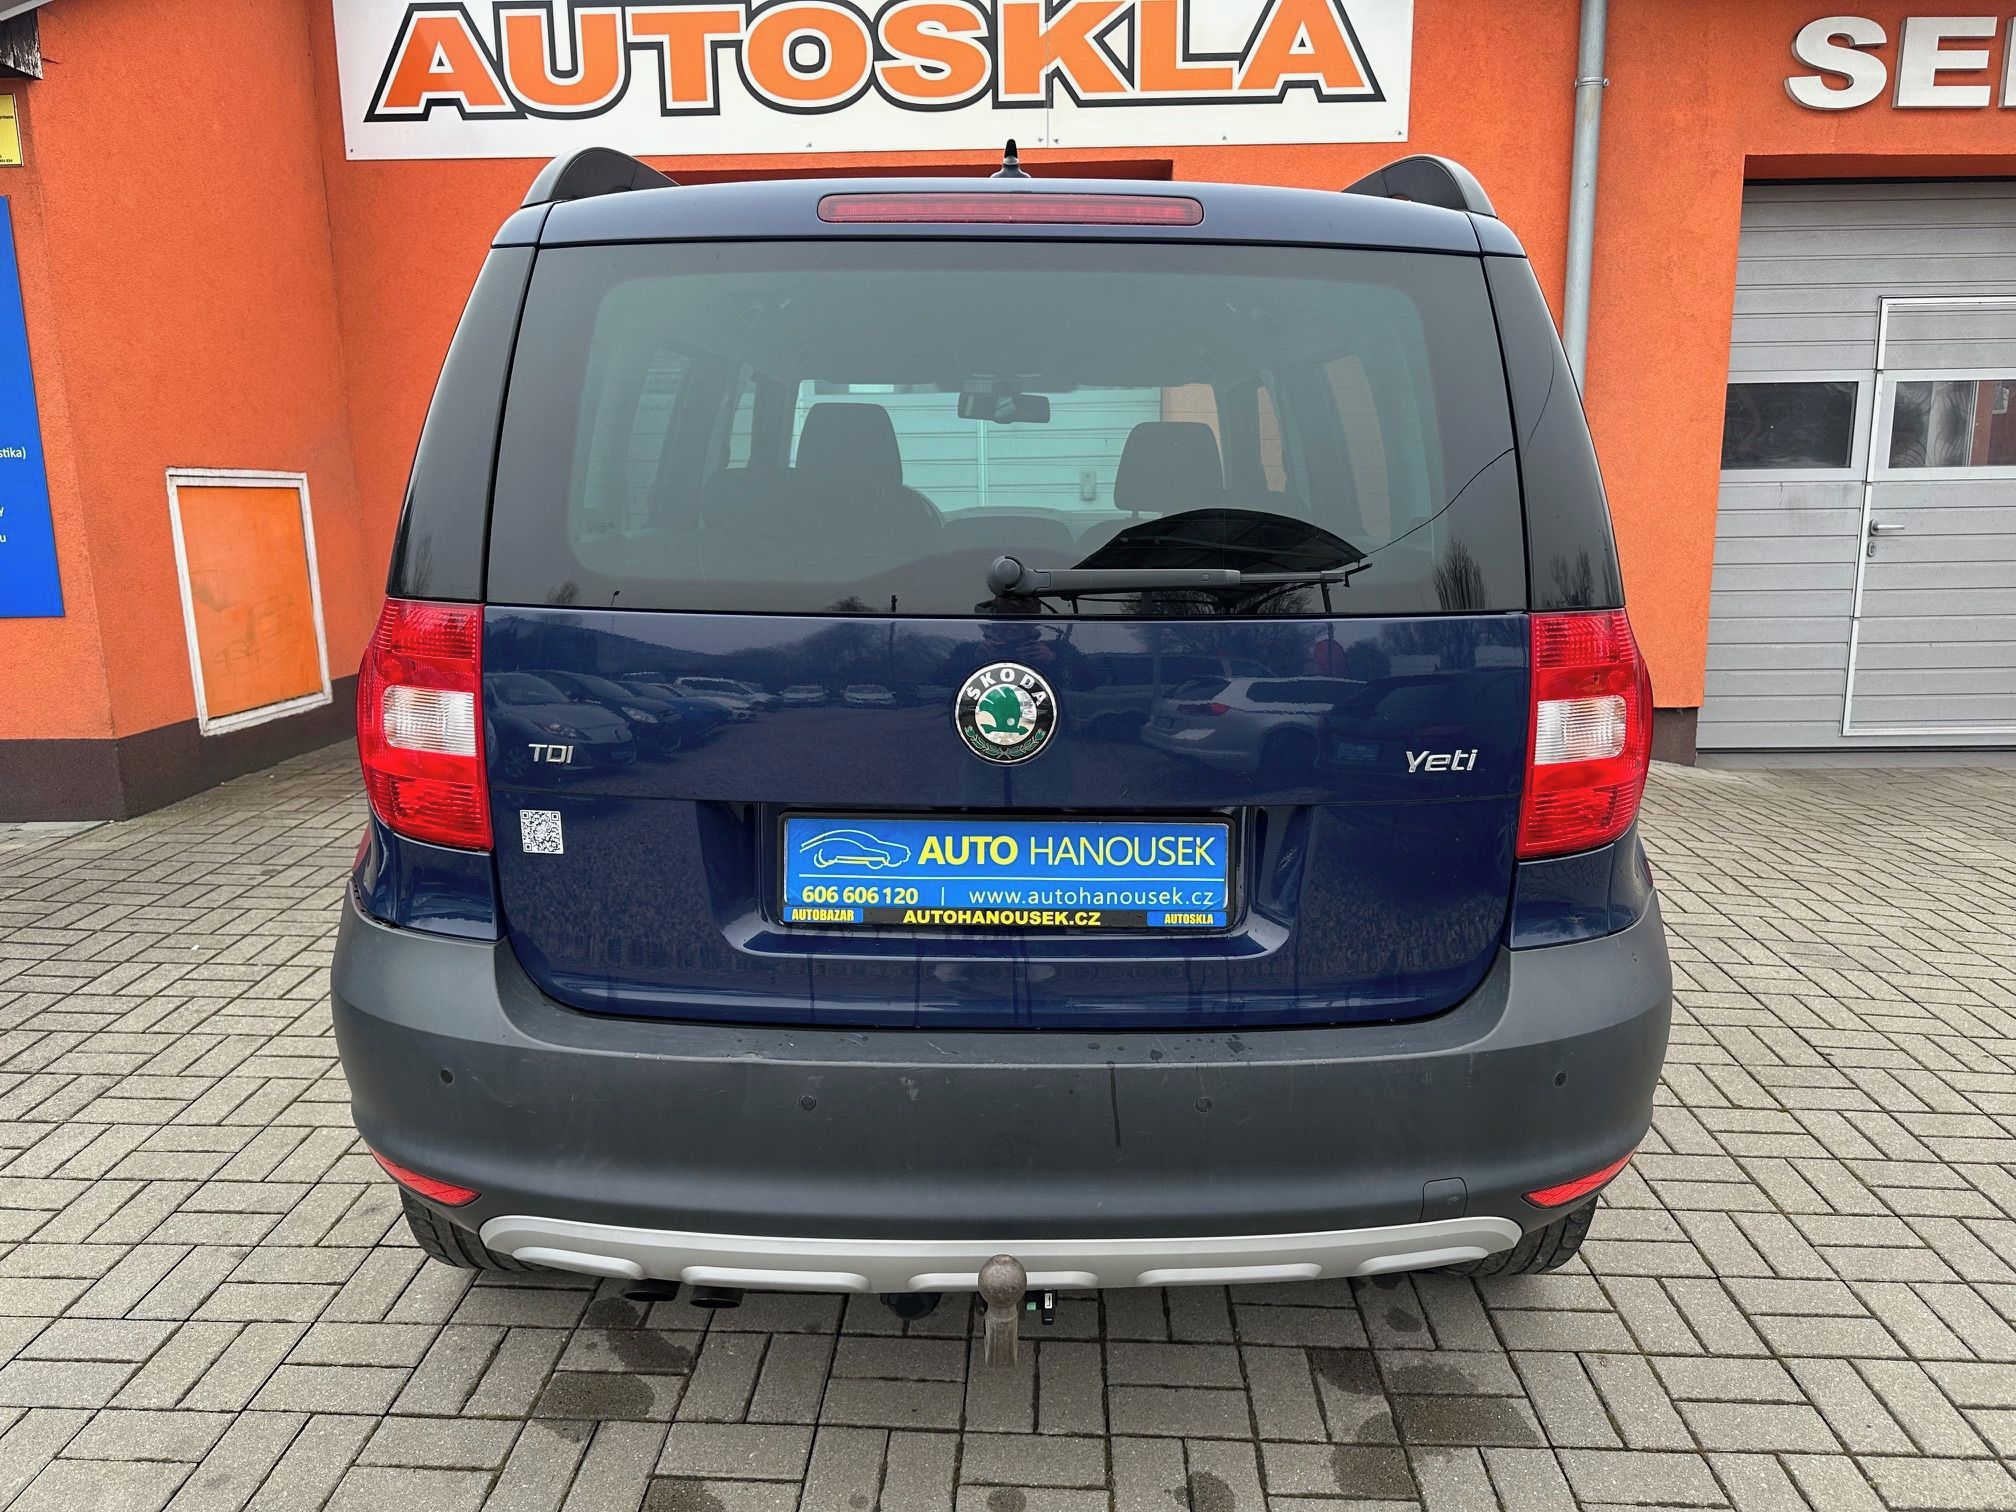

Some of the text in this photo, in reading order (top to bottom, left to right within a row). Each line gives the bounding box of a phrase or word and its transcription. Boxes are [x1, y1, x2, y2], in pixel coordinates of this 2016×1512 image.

[364, 0, 1386, 121] AUTOSKLA
[1784, 16, 2016, 110] SE
[528, 744, 575, 764] TDI
[1405, 749, 1478, 773] Yeti
[917, 835, 1215, 867] AUTO HANOUSEK
[802, 886, 919, 905] 606 606 120
[968, 885, 1214, 905] www.autohanousek.cz
[791, 908, 855, 922] AUTOBAZAR
[902, 909, 1102, 926] AUTOHANOUSEK.CZ
[1163, 912, 1214, 925] AUTOSKLA
